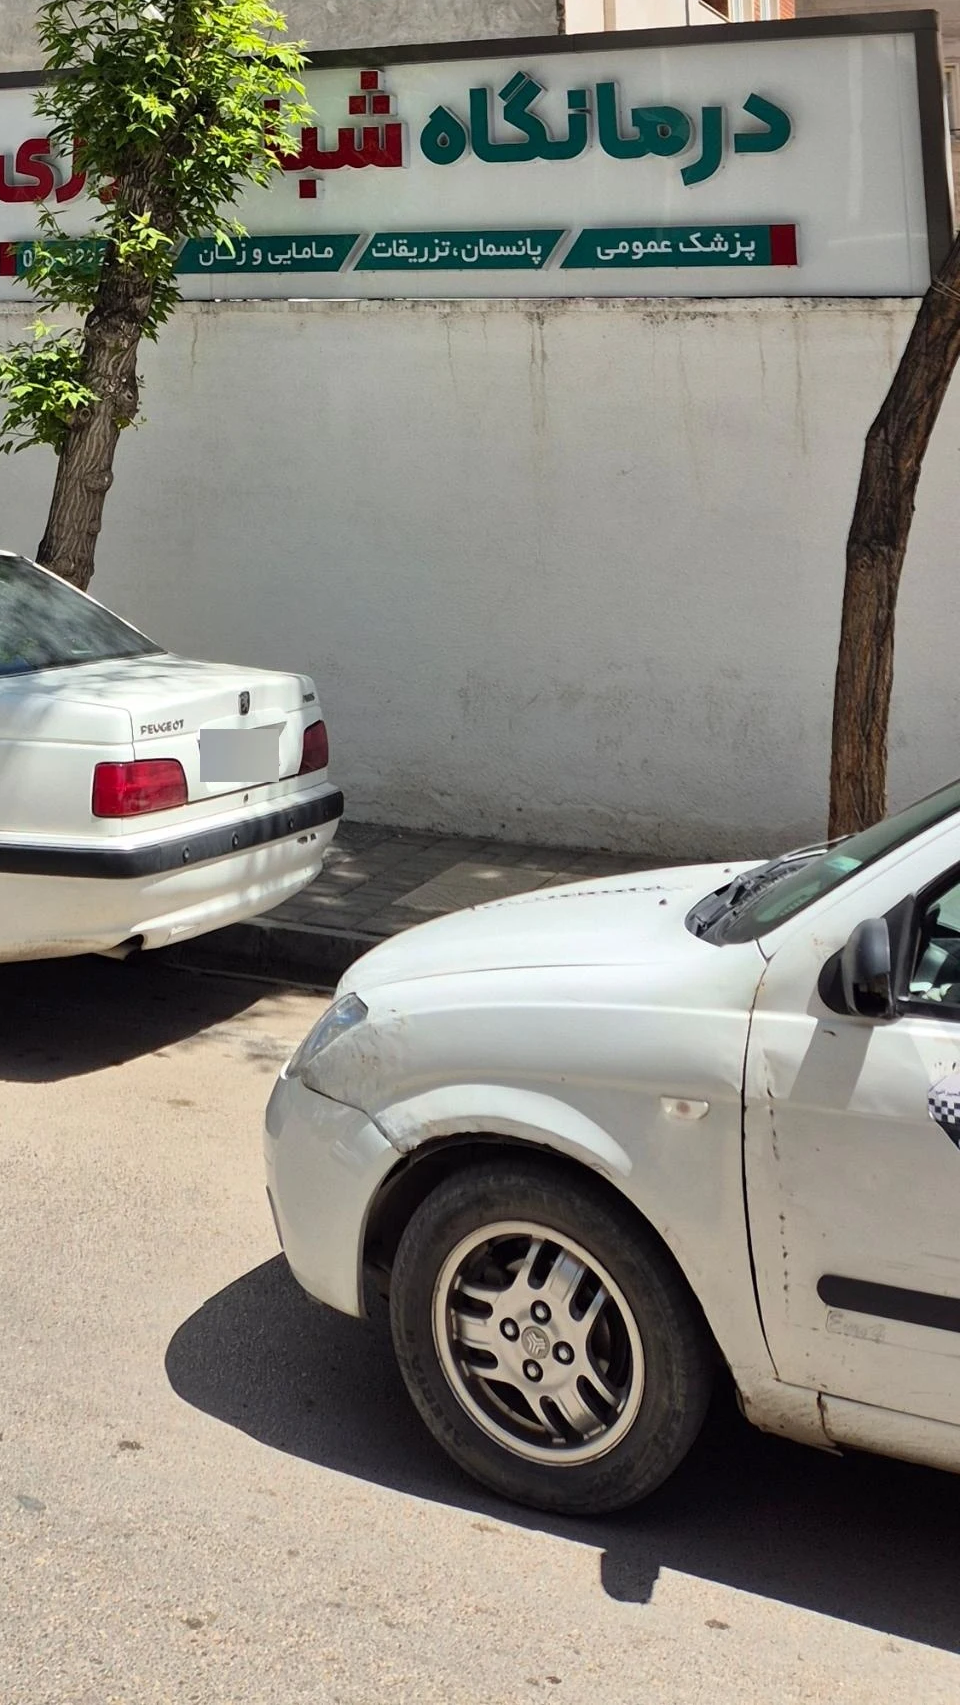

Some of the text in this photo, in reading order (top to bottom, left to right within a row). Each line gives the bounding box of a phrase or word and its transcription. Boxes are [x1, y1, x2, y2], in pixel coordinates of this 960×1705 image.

[243, 69, 404, 199] شبا
[420, 71, 791, 187] درمانگاه
[252, 248, 262, 266] و
[267, 240, 334, 265] مامایی
[596, 232, 756, 262] پزشک عمومی
[140, 718, 184, 735] PEUGEOT
